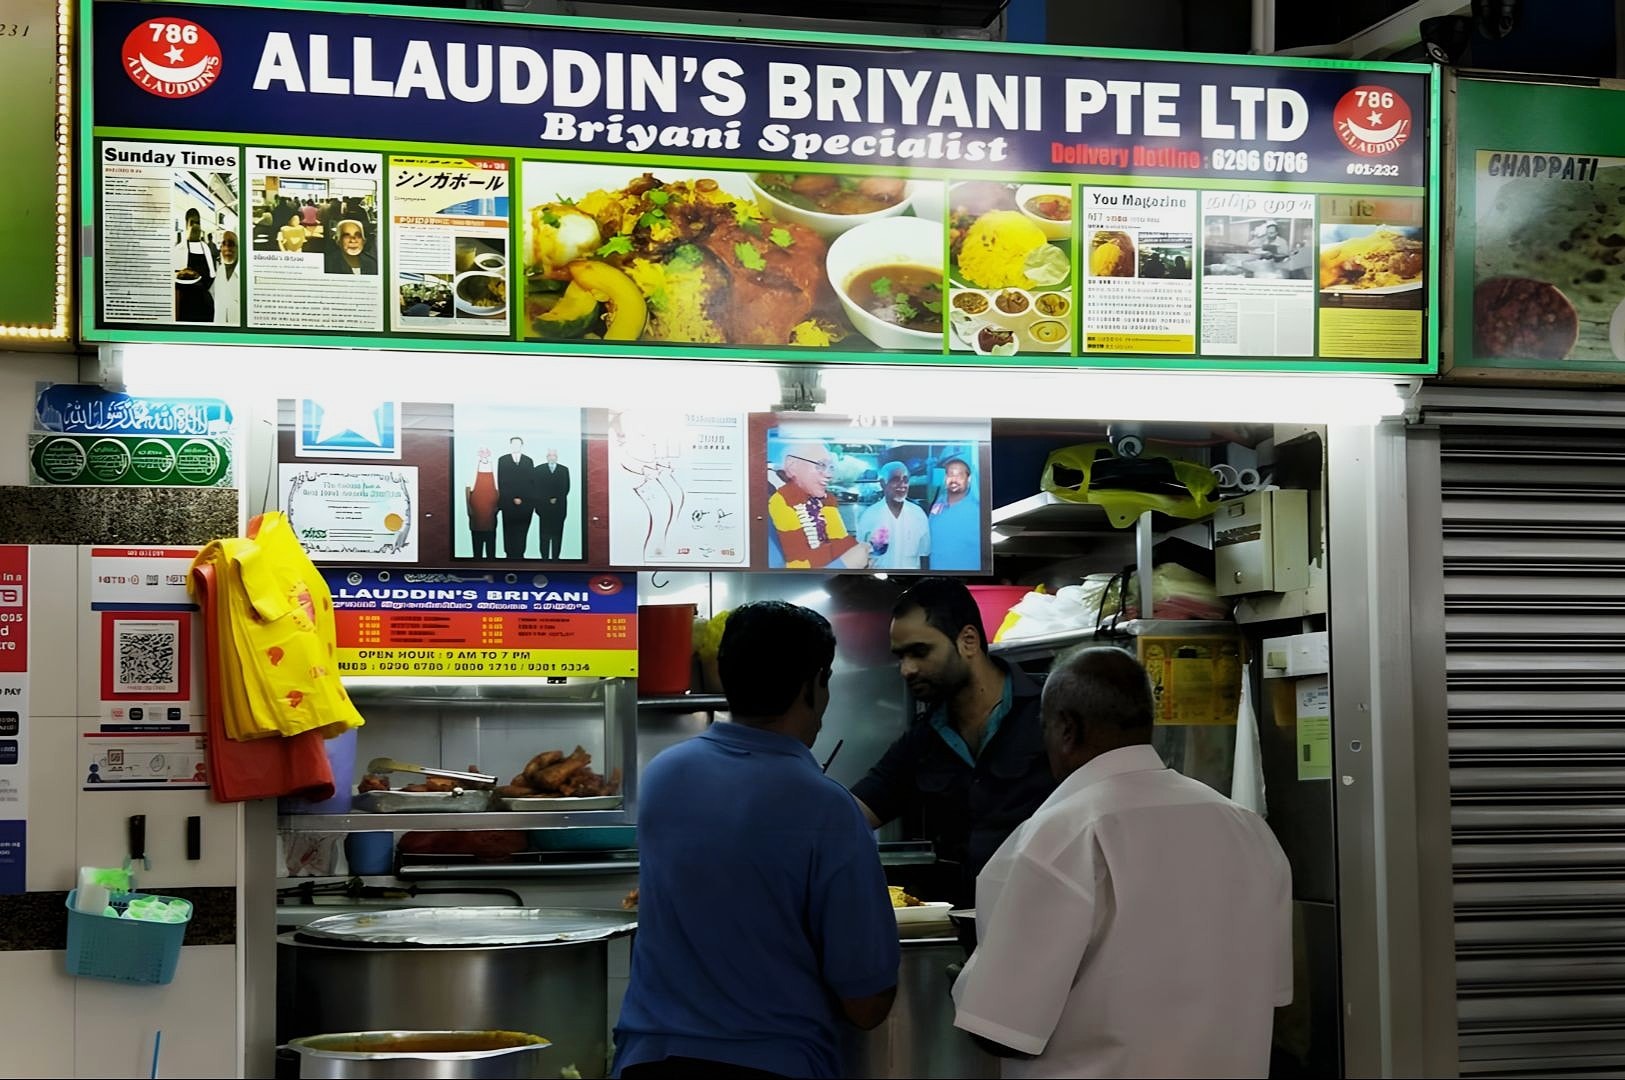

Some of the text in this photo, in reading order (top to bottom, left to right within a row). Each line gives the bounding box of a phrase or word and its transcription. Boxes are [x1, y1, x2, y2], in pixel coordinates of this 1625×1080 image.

[149, 23, 199, 45] 786
[127, 56, 220, 95] ALLAUDDIN'S
[252, 31, 1310, 142] ALLAUDDIN'S BRIYANI PTE LTD
[1354, 90, 1394, 109] 786
[540, 111, 1008, 163] Briyani Specialist
[104, 147, 236, 167] Sunday Times
[256, 154, 291, 170] The
[298, 156, 377, 174] Window
[1212, 148, 1260, 171] 6296
[1263, 151, 1308, 174] 6786
[1488, 152, 1600, 181] CHAPPATI
[1093, 193, 1118, 205] You
[331, 588, 589, 602] LAUDDIN'S BRIYANI
[358, 650, 394, 659] OPEN
[398, 651, 434, 659] HOUR
[458, 651, 477, 659] AM
[481, 651, 498, 660] TO
[501, 651, 509, 659] 7
[512, 651, 531, 660] PM
